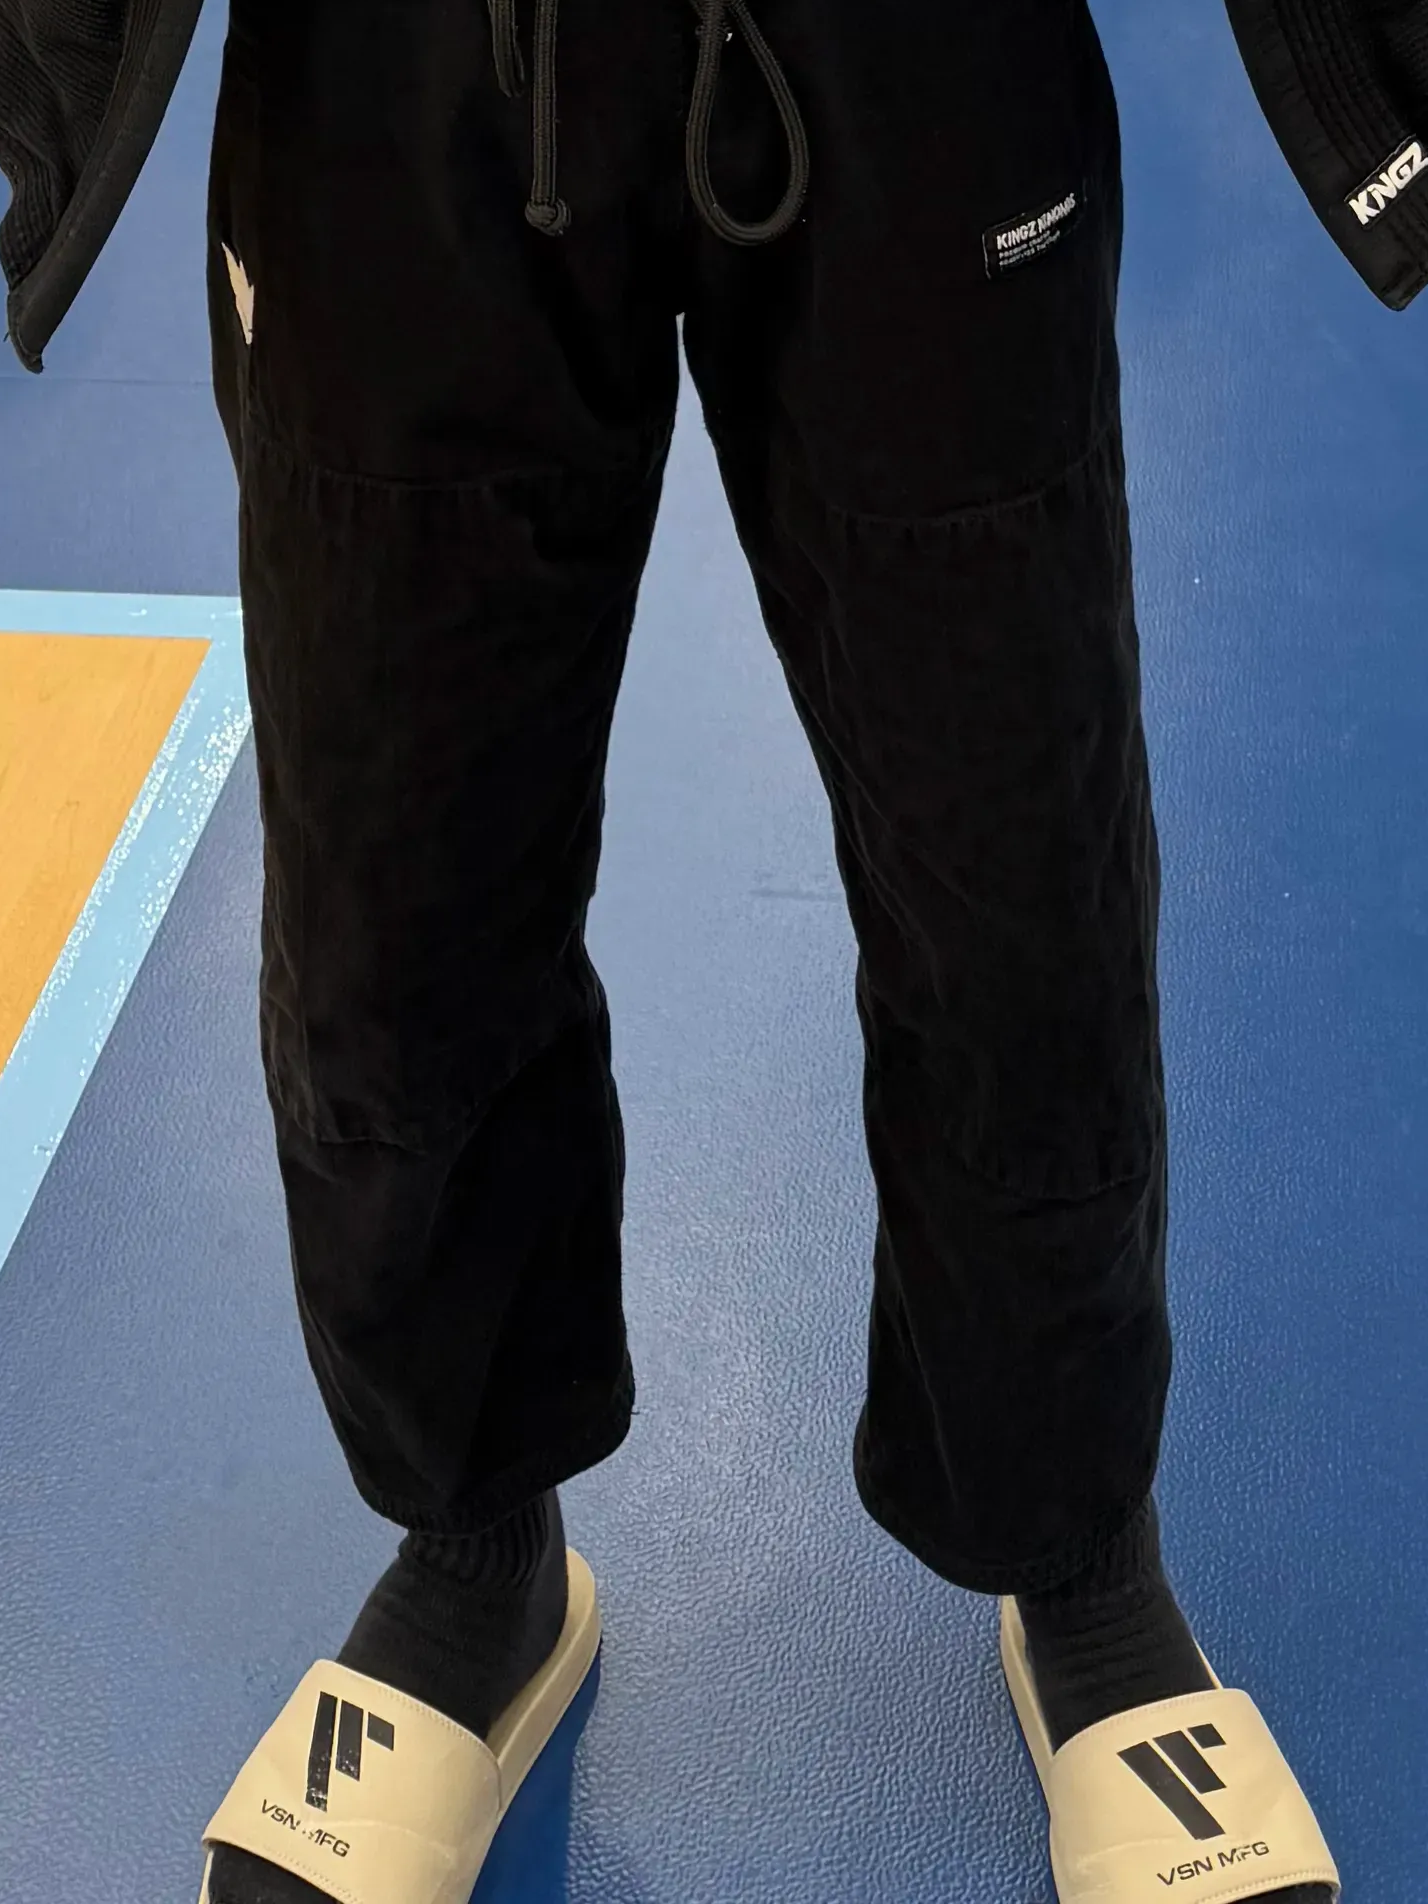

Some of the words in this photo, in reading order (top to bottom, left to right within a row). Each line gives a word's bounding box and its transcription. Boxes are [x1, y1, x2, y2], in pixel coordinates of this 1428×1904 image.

[996, 219, 1037, 250] KINGZ
[261, 1799, 302, 1830] VSN
[1156, 1856, 1214, 1886] VSN
[1217, 1841, 1270, 1868] MFG
